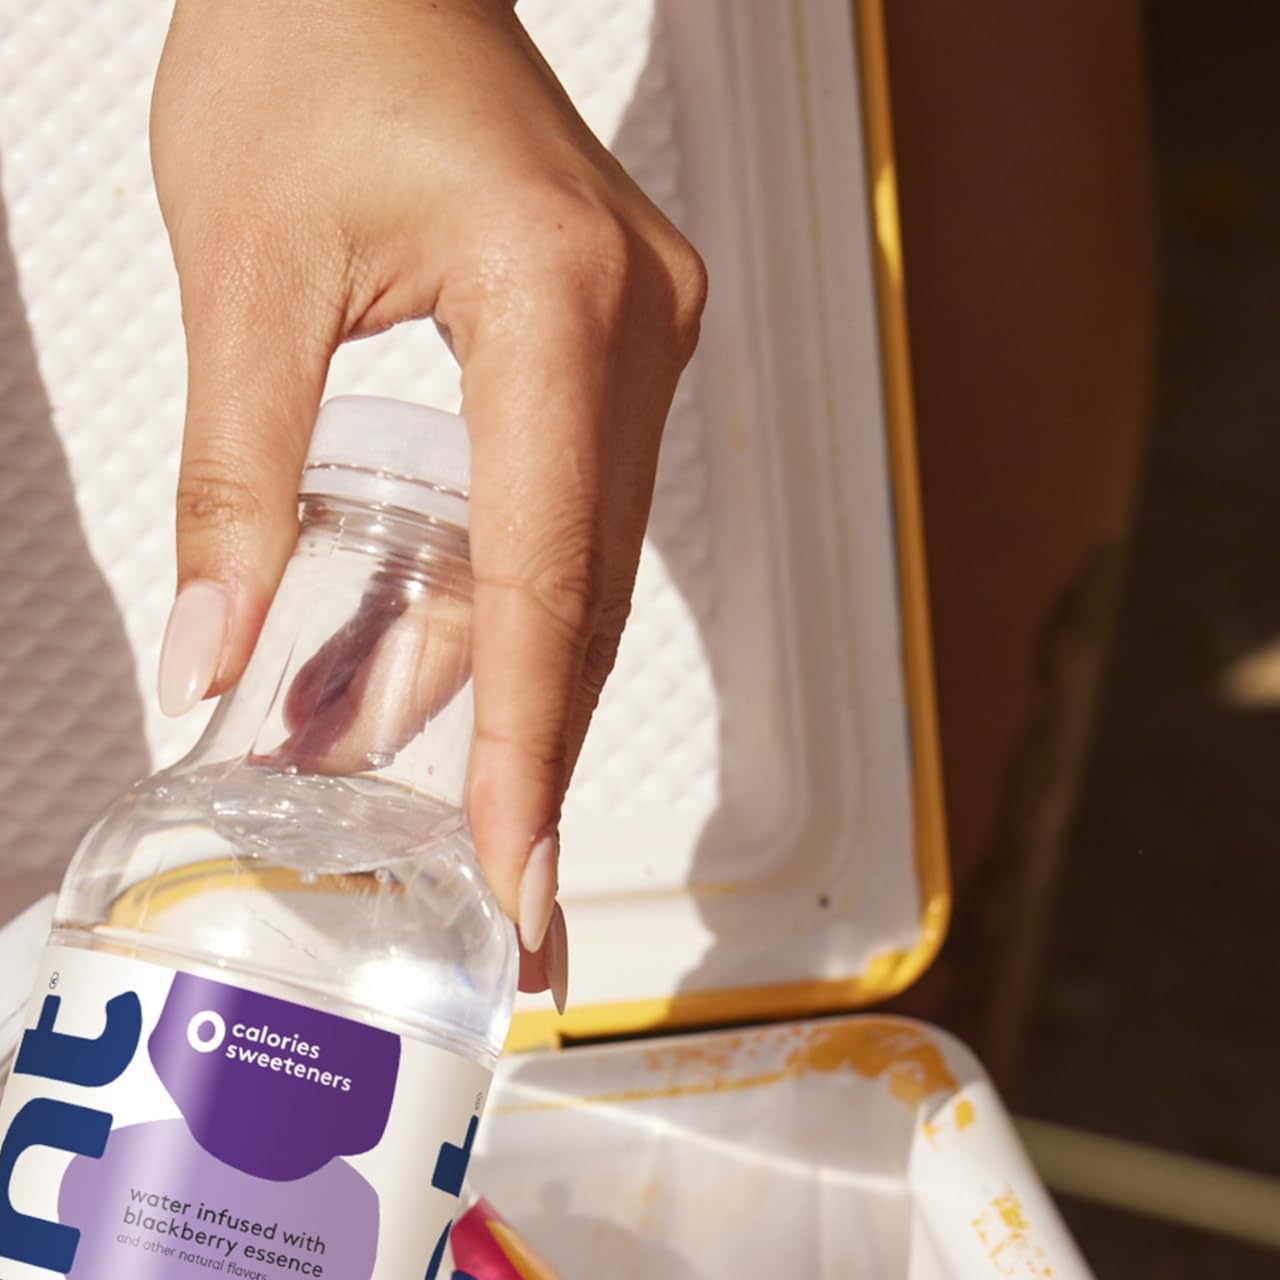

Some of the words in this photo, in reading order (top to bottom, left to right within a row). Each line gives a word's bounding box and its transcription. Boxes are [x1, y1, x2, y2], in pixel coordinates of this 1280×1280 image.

[187, 1010, 226, 1053] 0
[232, 1023, 321, 1059] calories
[225, 1044, 352, 1092] sweeteners
[123, 1206, 238, 1257] blackberry
[243, 1244, 324, 1278] essence
[130, 1188, 192, 1215] water
[196, 1202, 278, 1241] infused
[282, 1231, 326, 1255] with
[117, 1233, 139, 1248] and
[143, 1239, 175, 1257] other
[178, 1250, 225, 1272] natural
